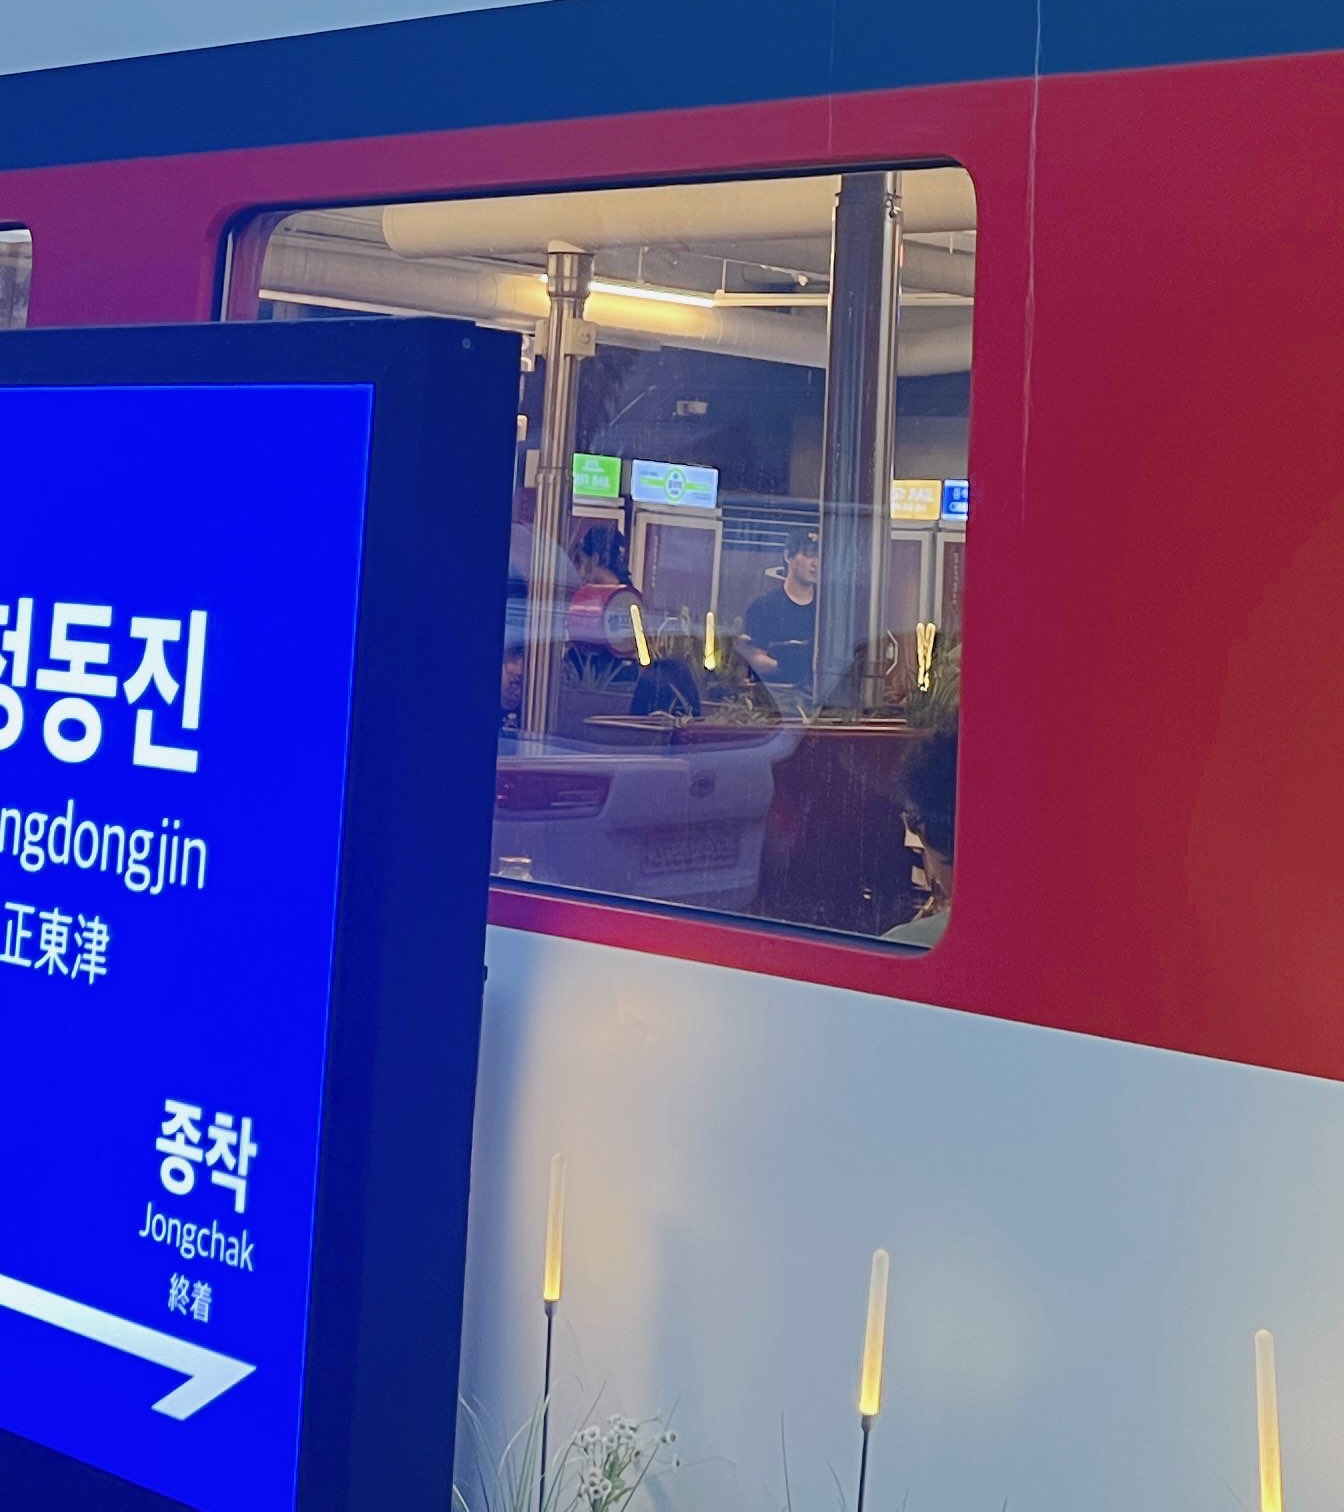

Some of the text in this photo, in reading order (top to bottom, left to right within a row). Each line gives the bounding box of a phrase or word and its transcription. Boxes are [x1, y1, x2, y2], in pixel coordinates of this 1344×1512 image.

[0, 901, 110, 985] 正東津
[155, 1098, 259, 1214] 종착
[139, 1201, 255, 1272] Jongchak
[167, 1271, 213, 1324] 終着
